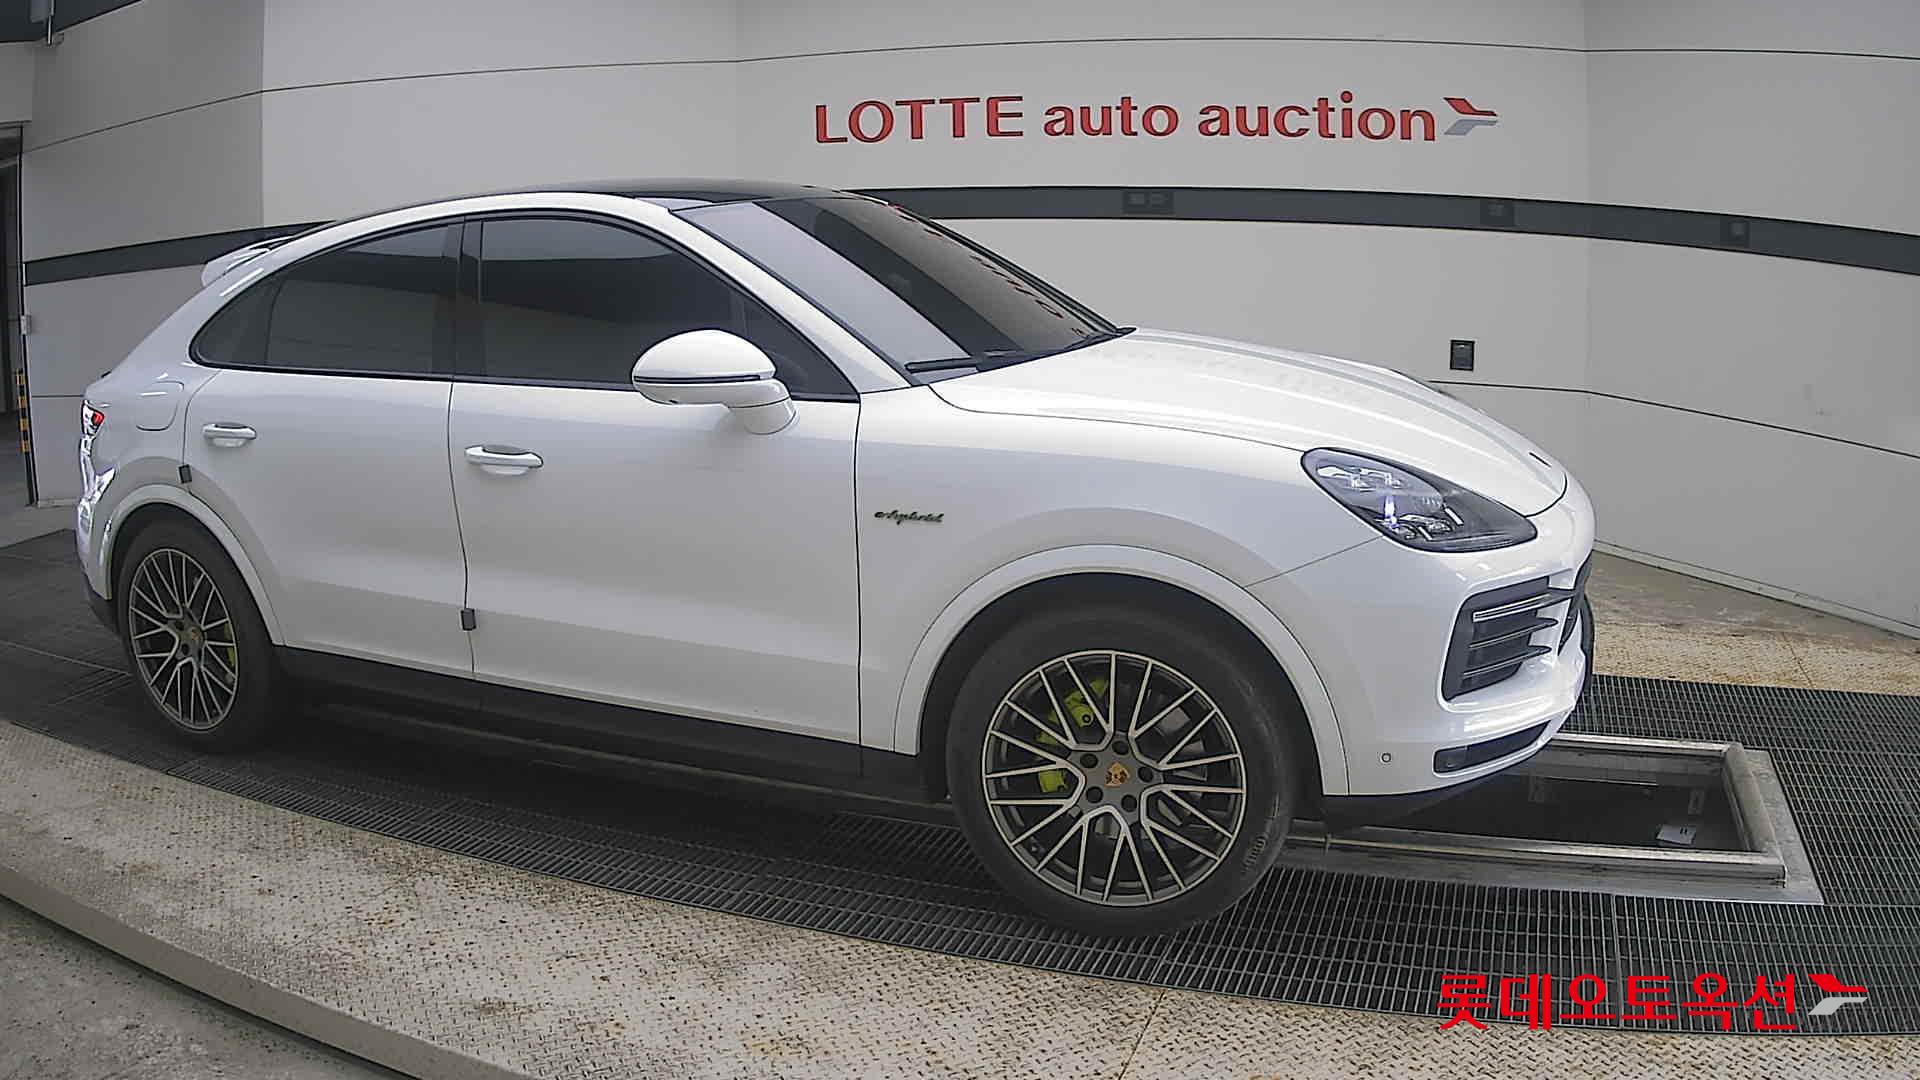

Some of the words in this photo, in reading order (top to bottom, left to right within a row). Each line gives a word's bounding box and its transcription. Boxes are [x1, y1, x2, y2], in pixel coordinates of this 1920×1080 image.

[815, 96, 1024, 144] LOTTE
[1043, 96, 1179, 137] auto
[1198, 90, 1436, 142] auction
